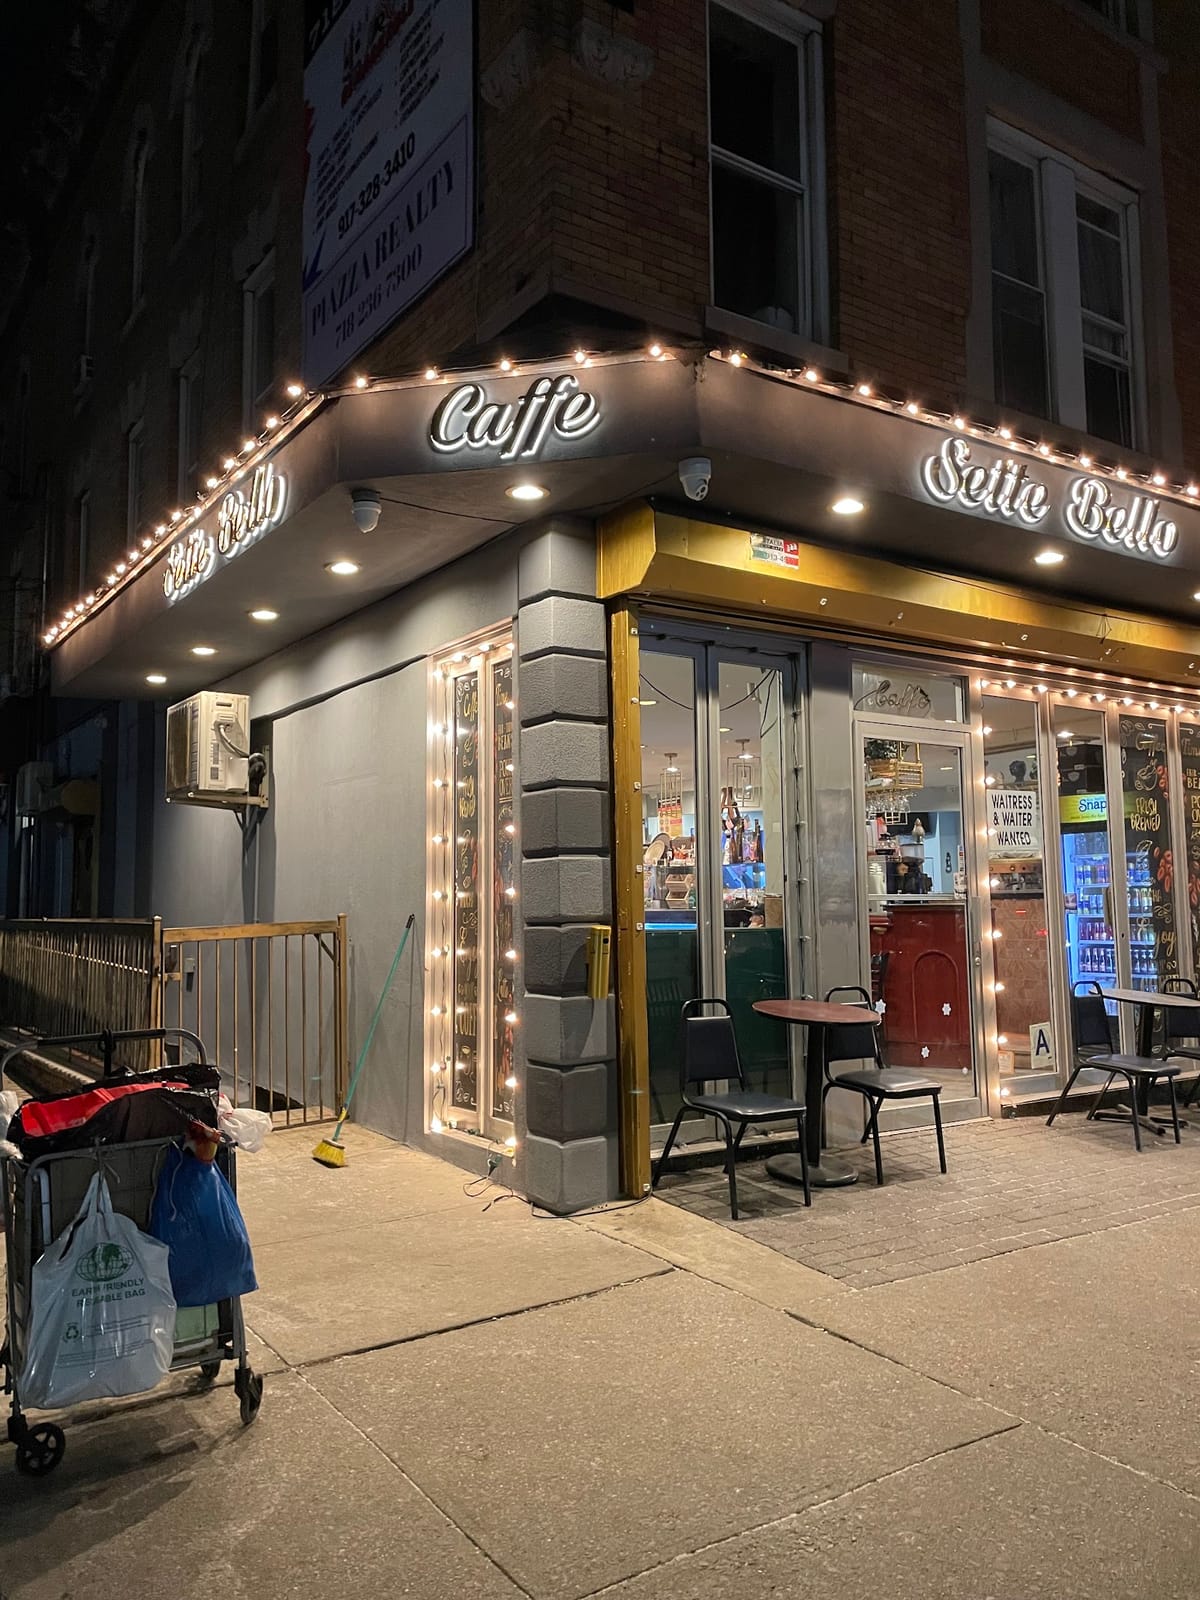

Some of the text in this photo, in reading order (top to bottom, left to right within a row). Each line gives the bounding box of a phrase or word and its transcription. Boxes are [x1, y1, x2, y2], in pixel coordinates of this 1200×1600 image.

[338, 132, 415, 239] 917-328-3410
[311, 252, 371, 337] PIAZZA
[374, 160, 454, 271] REALTY
[430, 374, 600, 459] Caffe
[920, 436, 1179, 557] Sette Bello
[992, 794, 1033, 810] WAITRESS
[1135, 798, 1158, 817] FRESH
[993, 812, 1032, 827] & WAITER
[996, 831, 1031, 846] WANTED
[1035, 1029, 1050, 1056] A
[125, 1288, 146, 1300] BAG
